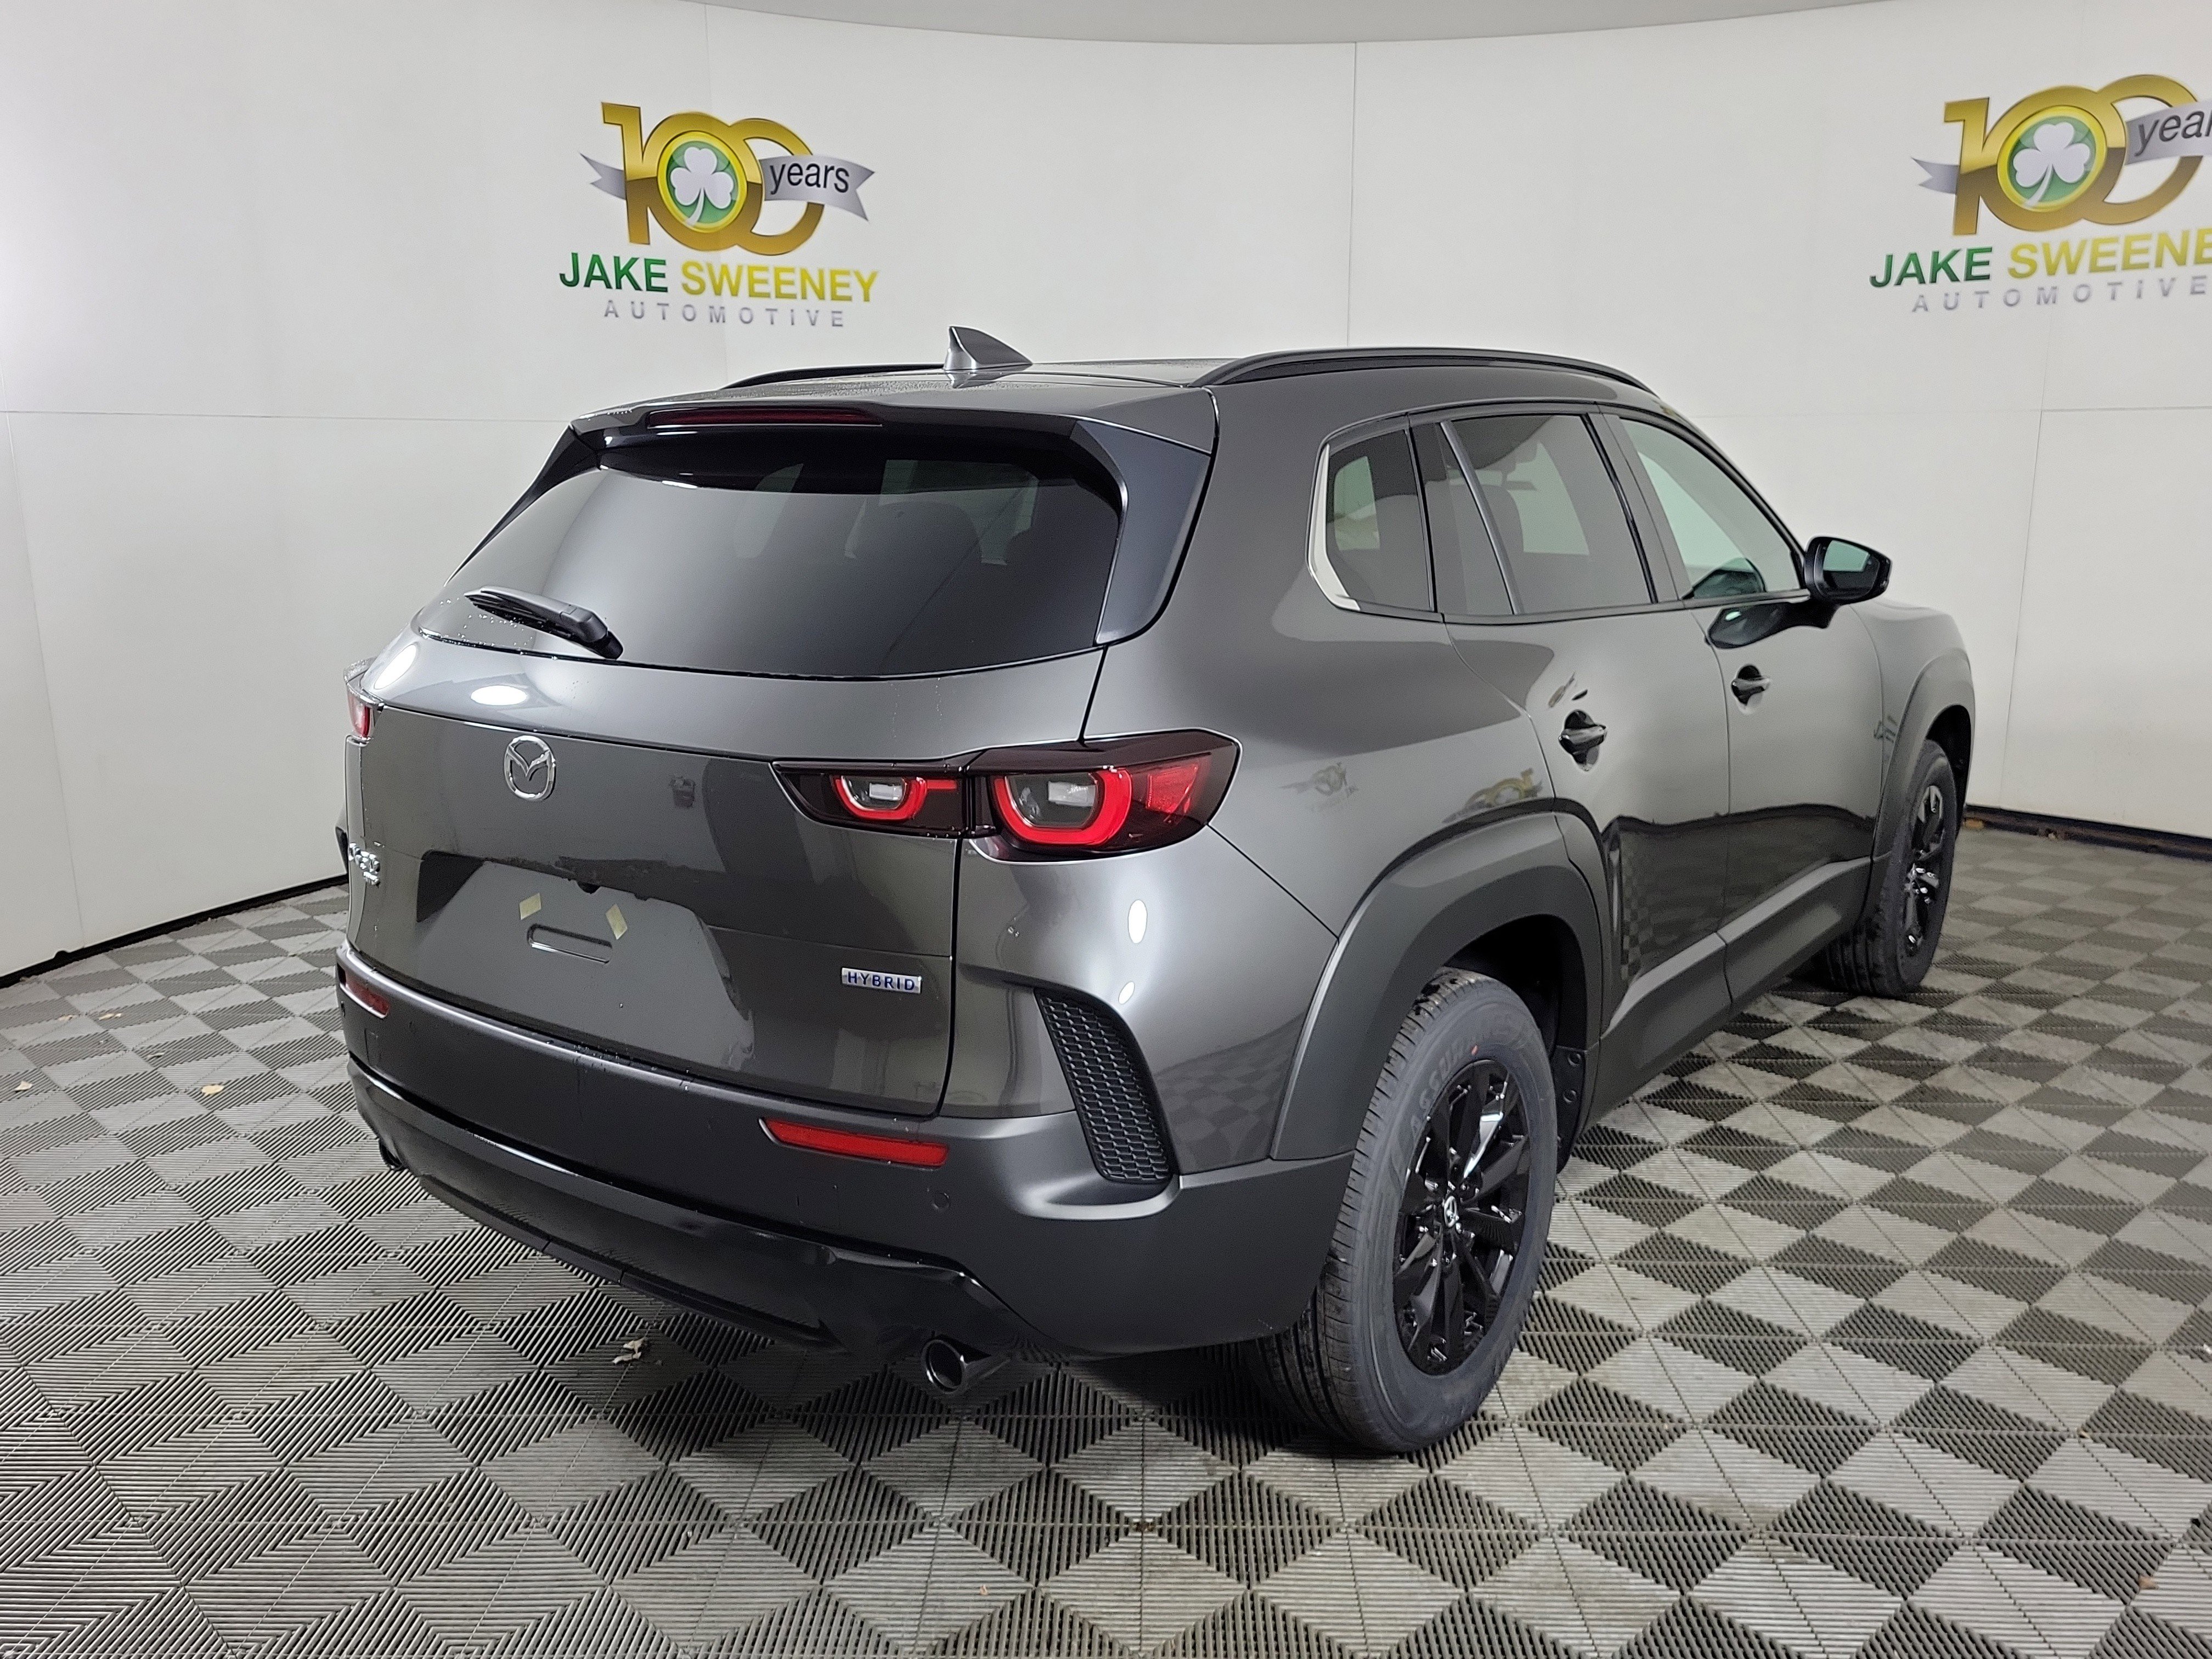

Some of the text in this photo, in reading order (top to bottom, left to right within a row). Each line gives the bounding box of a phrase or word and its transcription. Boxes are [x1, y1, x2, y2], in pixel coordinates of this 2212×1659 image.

[769, 162, 850, 195] years
[559, 252, 880, 303] JAKE SWEENEY
[1869, 246, 1993, 289] JAKE
[1911, 275, 2208, 313] AUTOMOTIVE
[603, 300, 844, 328] AUTOMOTIVE
[848, 971, 915, 991] HYBRID
